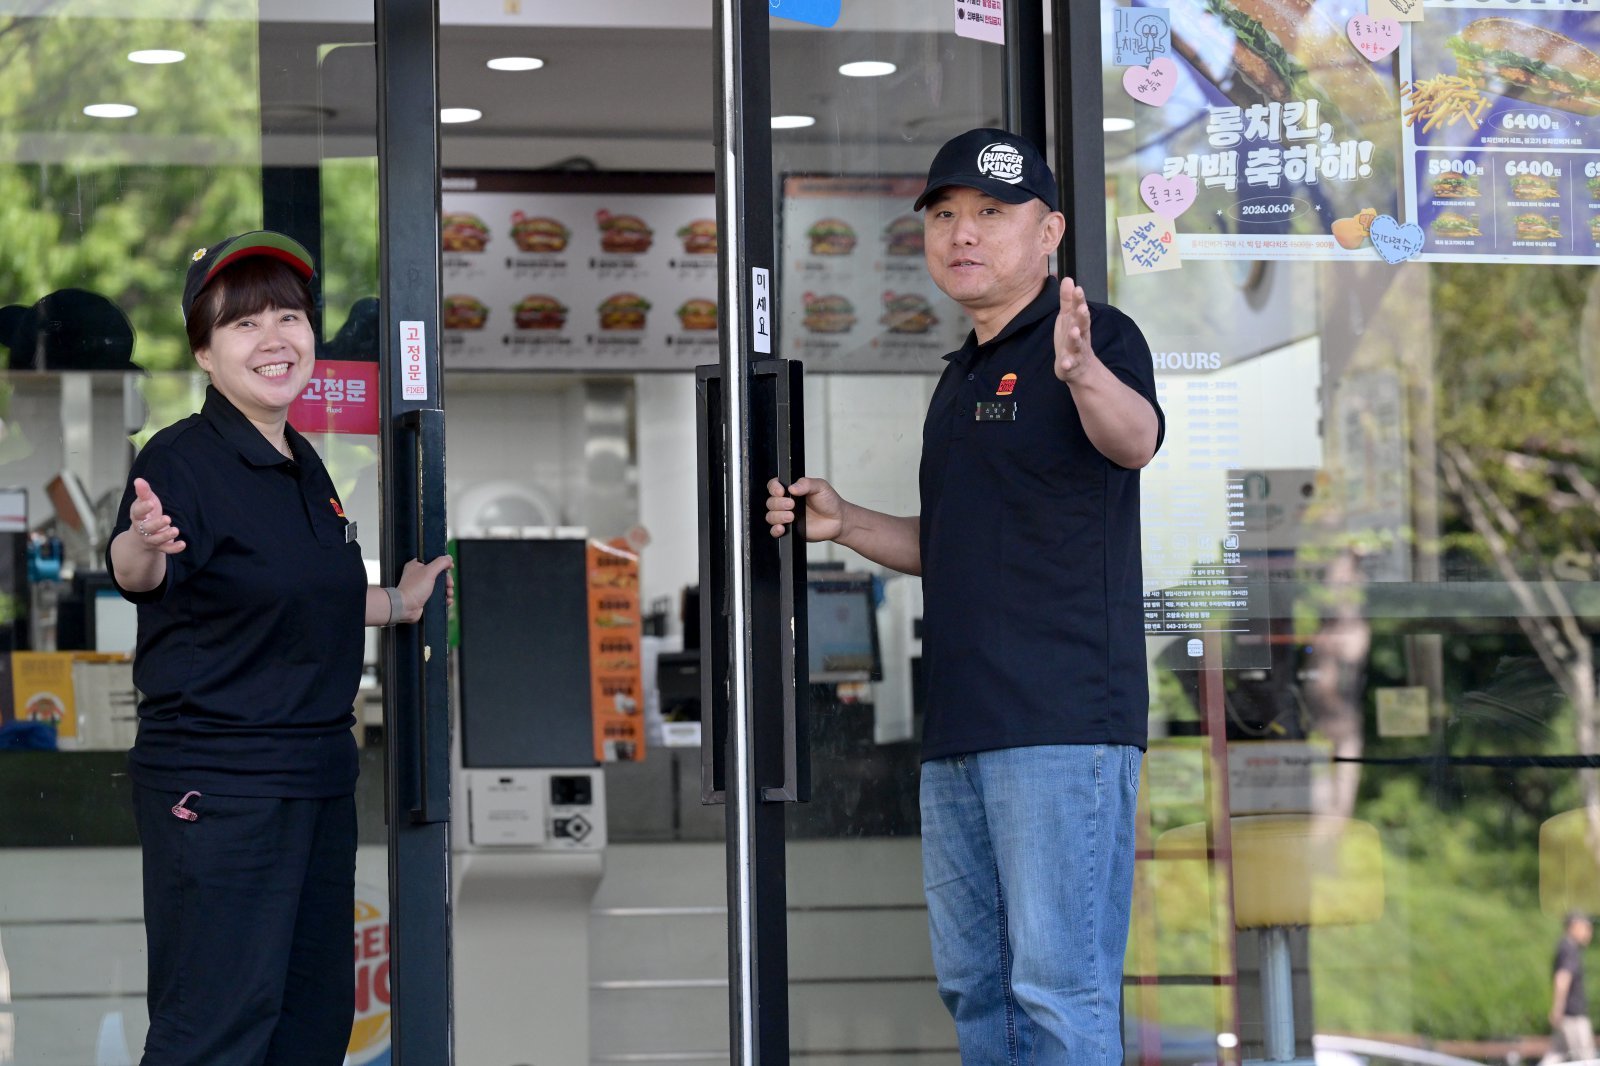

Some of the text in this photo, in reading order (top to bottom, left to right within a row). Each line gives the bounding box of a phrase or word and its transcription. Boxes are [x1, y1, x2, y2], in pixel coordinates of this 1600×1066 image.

[1354, 20, 1391, 36] 롱치킨
[1206, 98, 1334, 148] 롱치킨,
[1502, 113, 1560, 130] 6400원
[983, 152, 1023, 164] BURGER
[1245, 140, 1375, 188] 축하해!
[983, 162, 1022, 175] KING
[1505, 160, 1562, 176] 6400원
[1242, 204, 1296, 215] 2026.06.04
[757, 274, 768, 336] 미세요
[407, 327, 421, 380] 고정문
[1152, 352, 1221, 369] HOURS
[302, 378, 366, 402] 고정문
